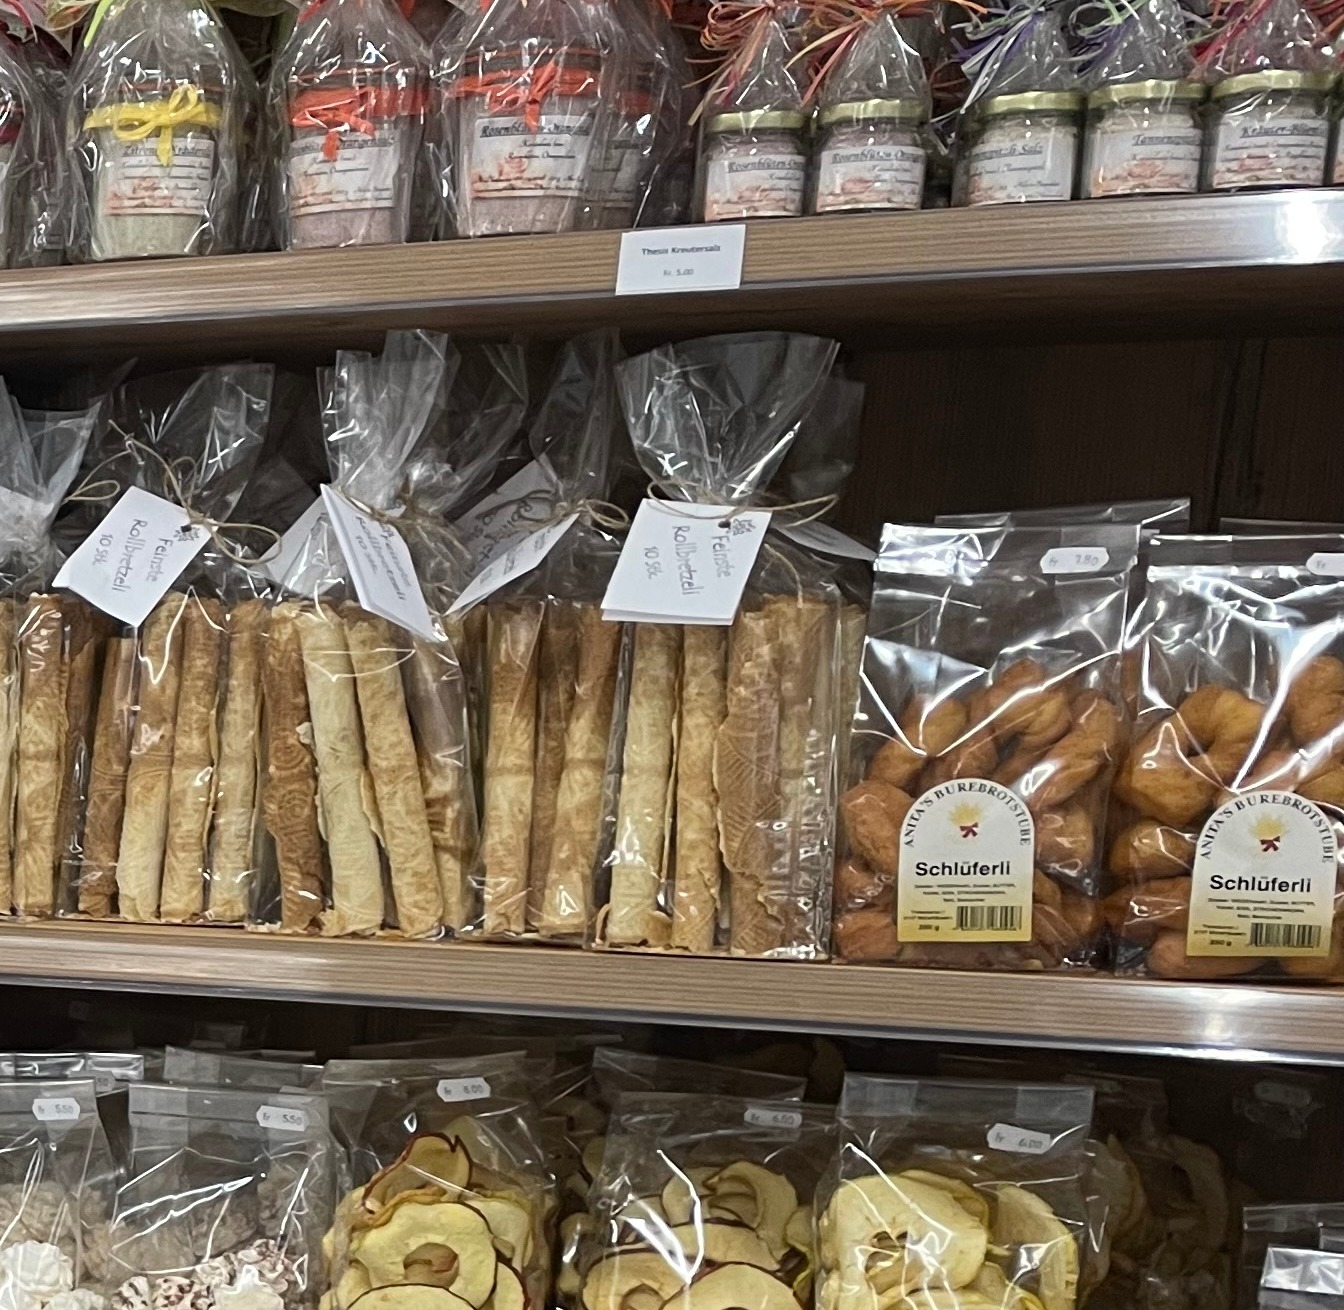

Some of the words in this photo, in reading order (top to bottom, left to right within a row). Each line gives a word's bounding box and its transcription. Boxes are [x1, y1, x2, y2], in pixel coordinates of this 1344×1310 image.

[644, 545, 660, 560] 10
[711, 535, 736, 579] Feinste
[902, 796, 934, 848] ANITA'S
[934, 780, 1032, 847] BUREBROTSTUBE
[1199, 803, 1235, 860] ANITA'S
[1235, 793, 1335, 865] BUREBROTSTUBE
[914, 860, 1011, 878] Schlüferli
[1209, 874, 1312, 894] Schlüferli
